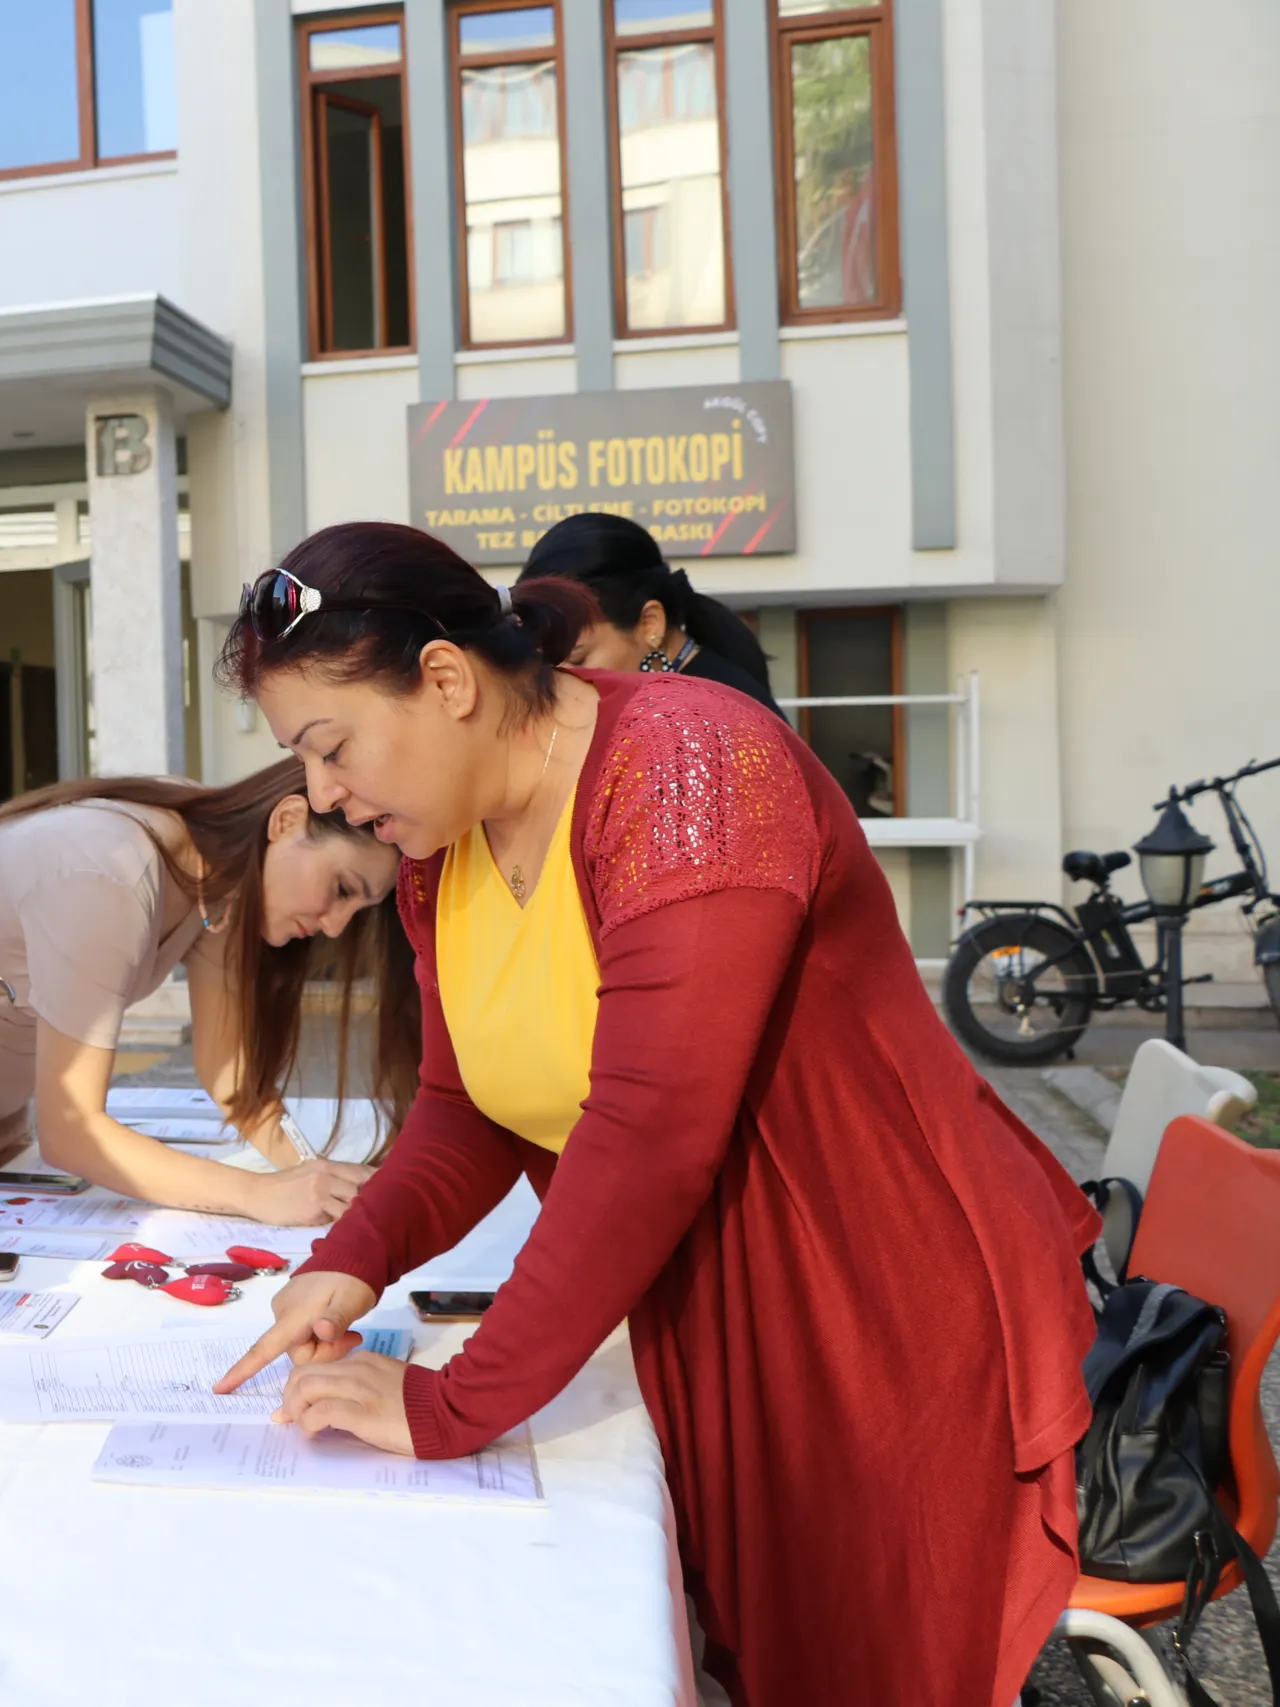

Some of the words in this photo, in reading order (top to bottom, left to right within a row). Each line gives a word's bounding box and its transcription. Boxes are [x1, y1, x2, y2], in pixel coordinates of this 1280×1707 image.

[95, 412, 152, 476] B
[444, 430, 578, 494] KAMPÜS
[588, 418, 742, 488] FOTOKOPİ
[425, 506, 516, 528] TARAMA
[652, 491, 767, 517] FOTOKOPİ
[476, 531, 516, 549] TEZ
